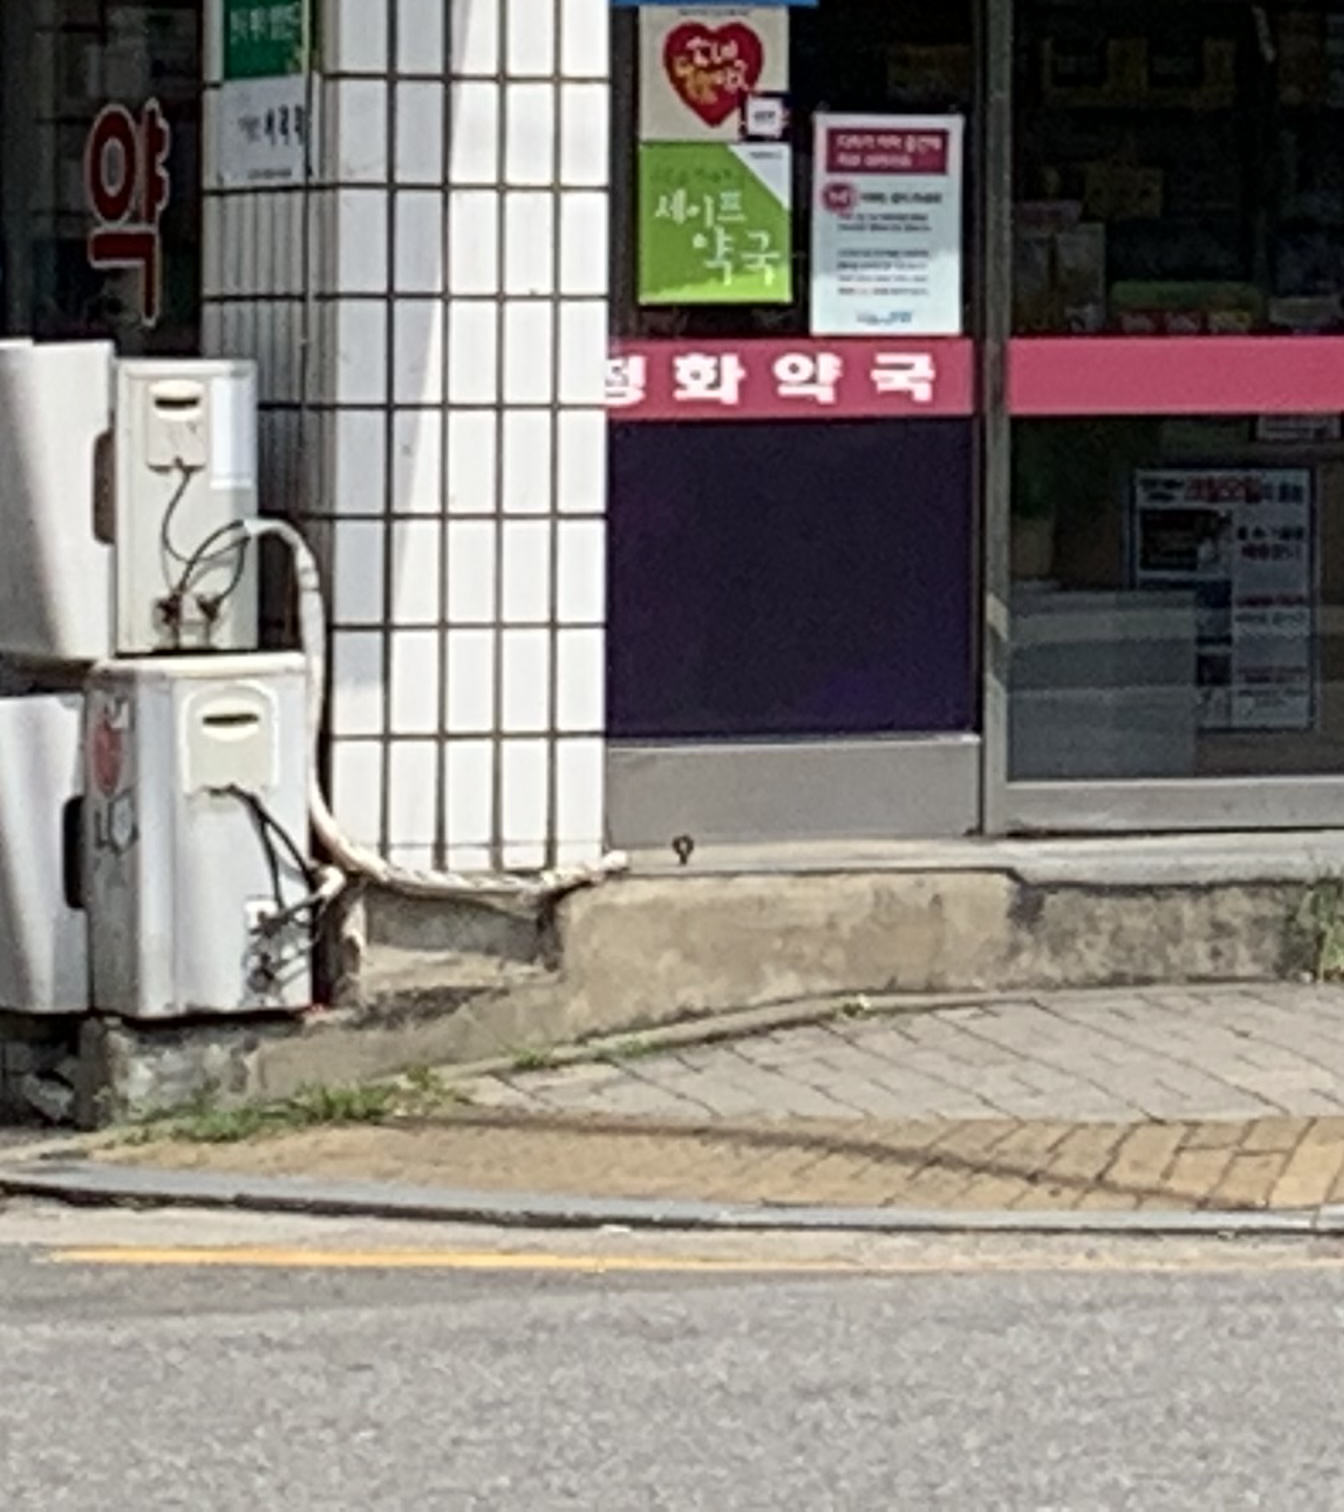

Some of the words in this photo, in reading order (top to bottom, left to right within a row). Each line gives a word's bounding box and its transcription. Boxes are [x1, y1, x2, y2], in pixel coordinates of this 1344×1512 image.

[84, 97, 171, 329] 약
[653, 187, 748, 229] 세이프
[692, 226, 781, 287] 약국
[604, 353, 936, 405] 정화약국
